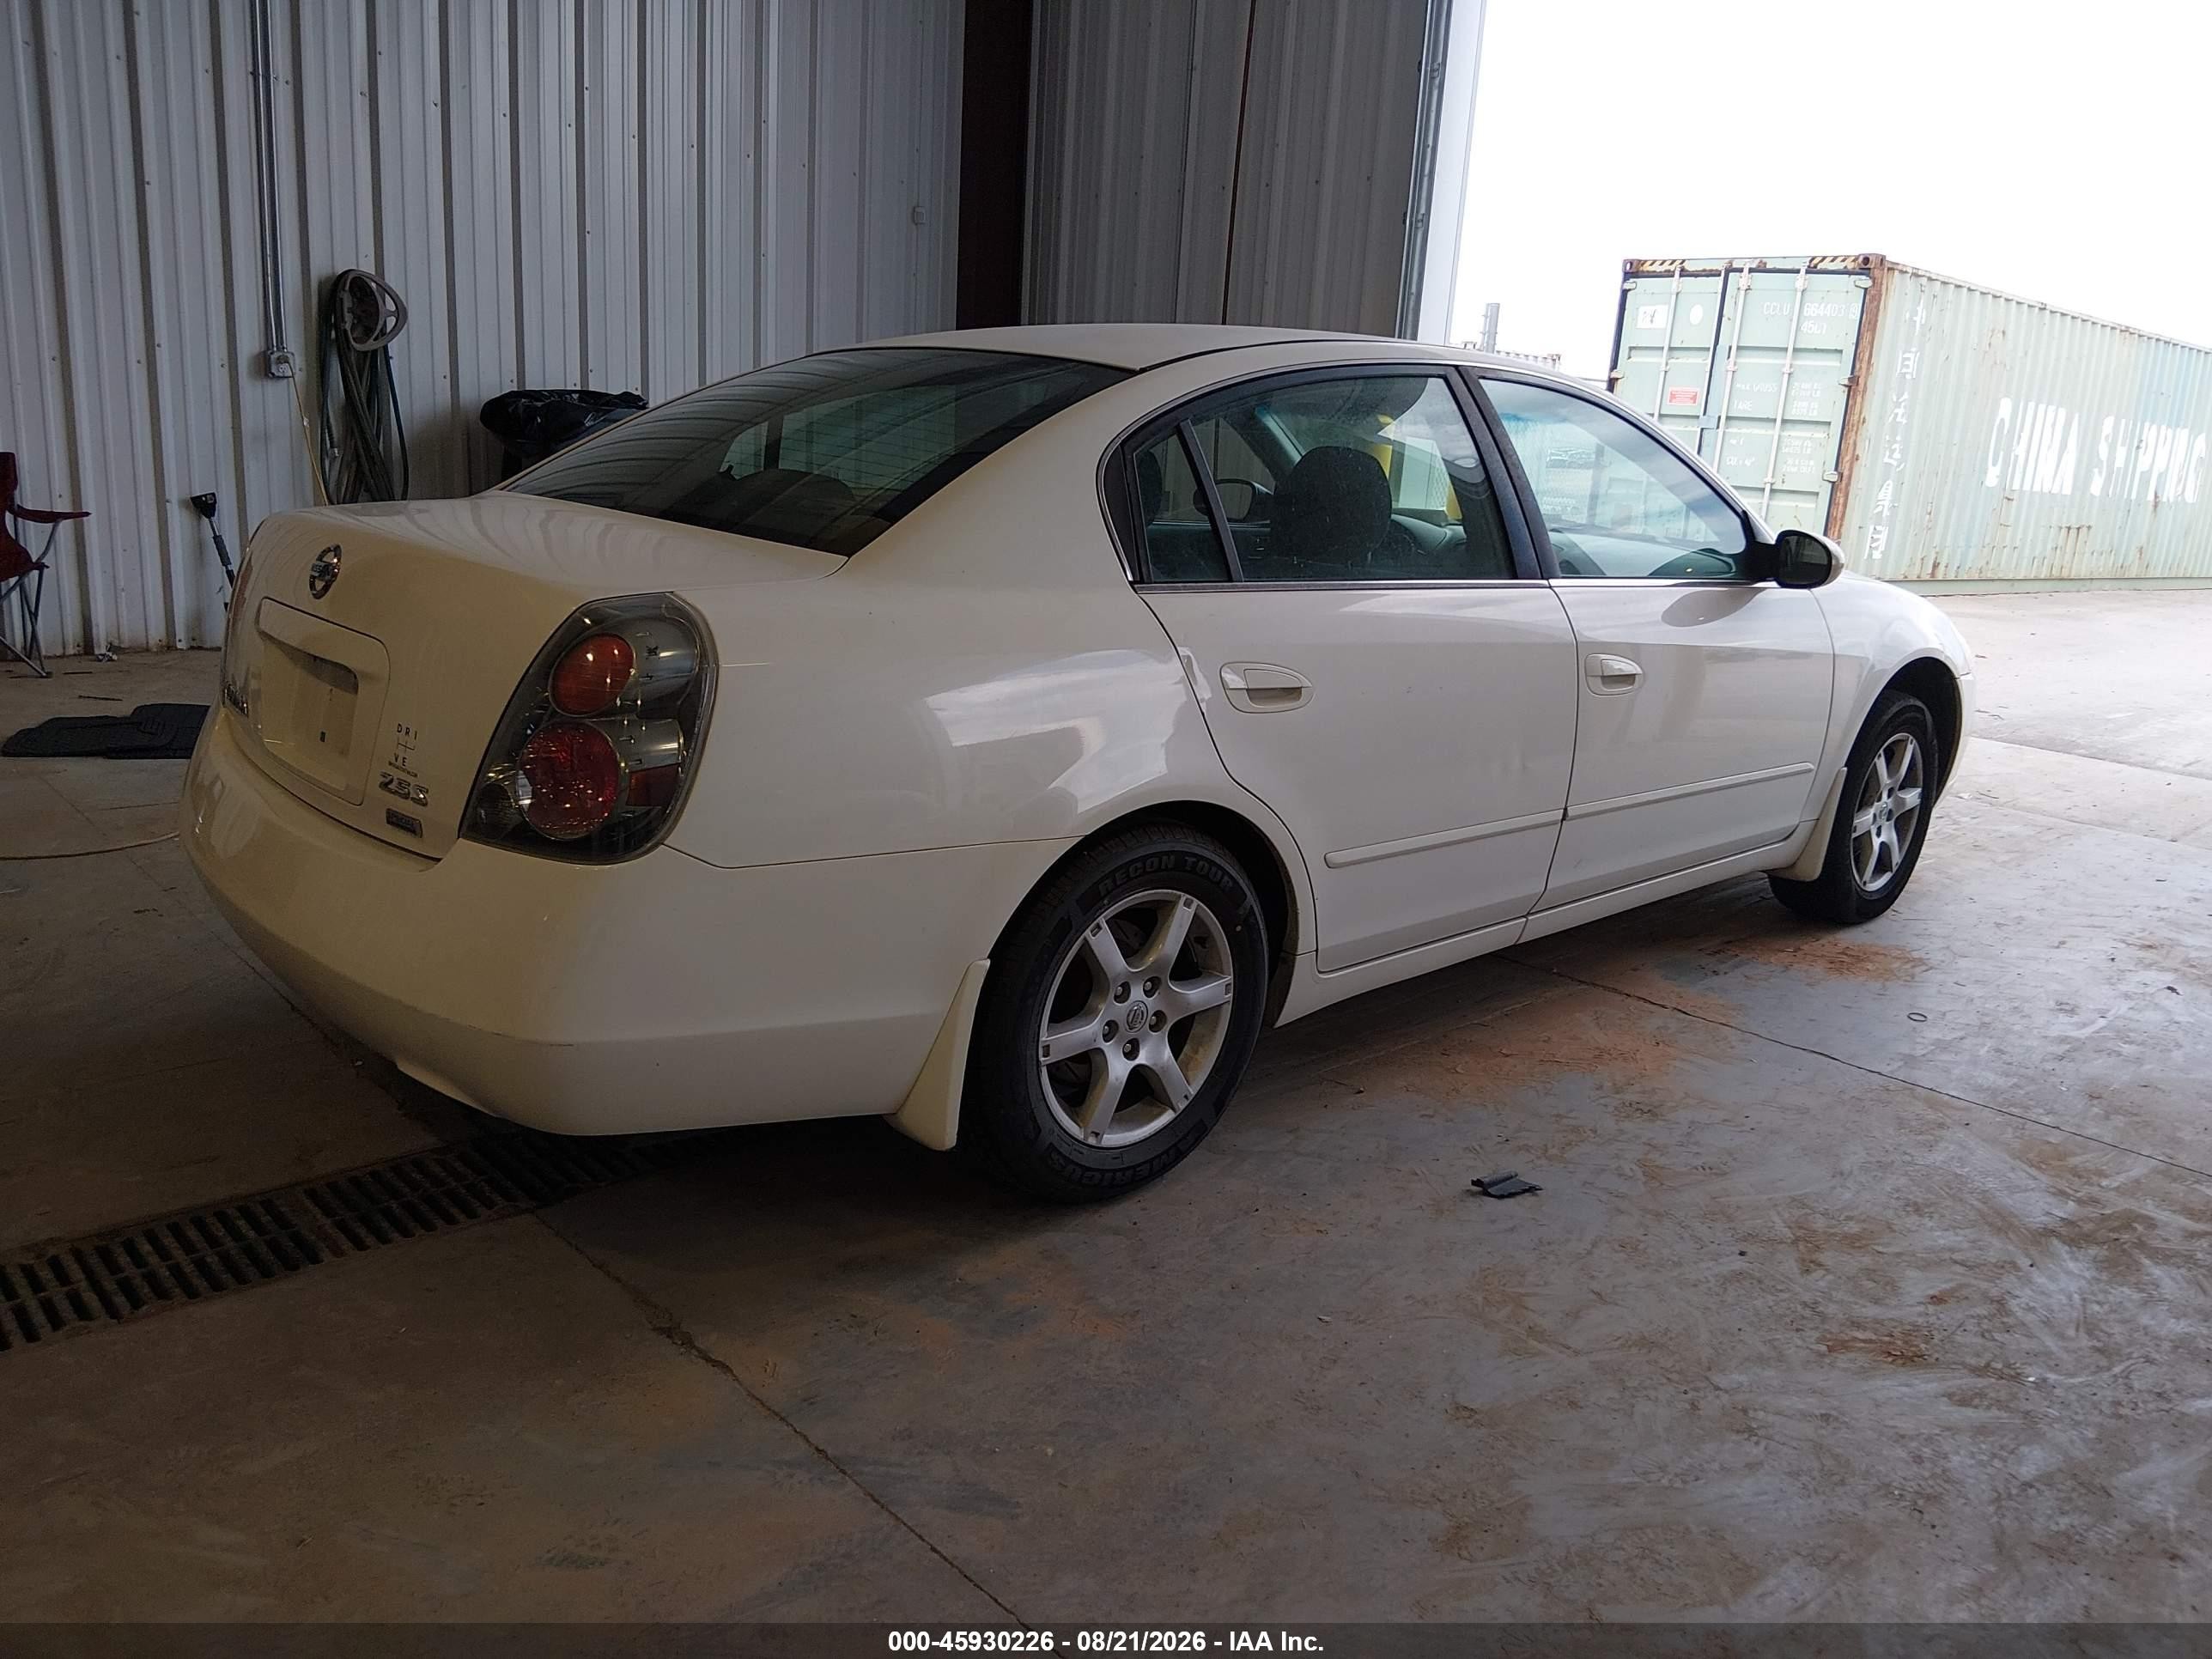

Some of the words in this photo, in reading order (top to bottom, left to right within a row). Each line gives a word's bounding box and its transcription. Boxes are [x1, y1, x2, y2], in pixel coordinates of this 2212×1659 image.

[1762, 301, 1790, 316] CCLU
[1802, 302, 1845, 317] 664403
[1984, 397, 2078, 495] CHINA
[2090, 416, 2207, 503] SHIPPING
[1098, 854, 1176, 897] RECON
[1184, 855, 1234, 888] TOUR
